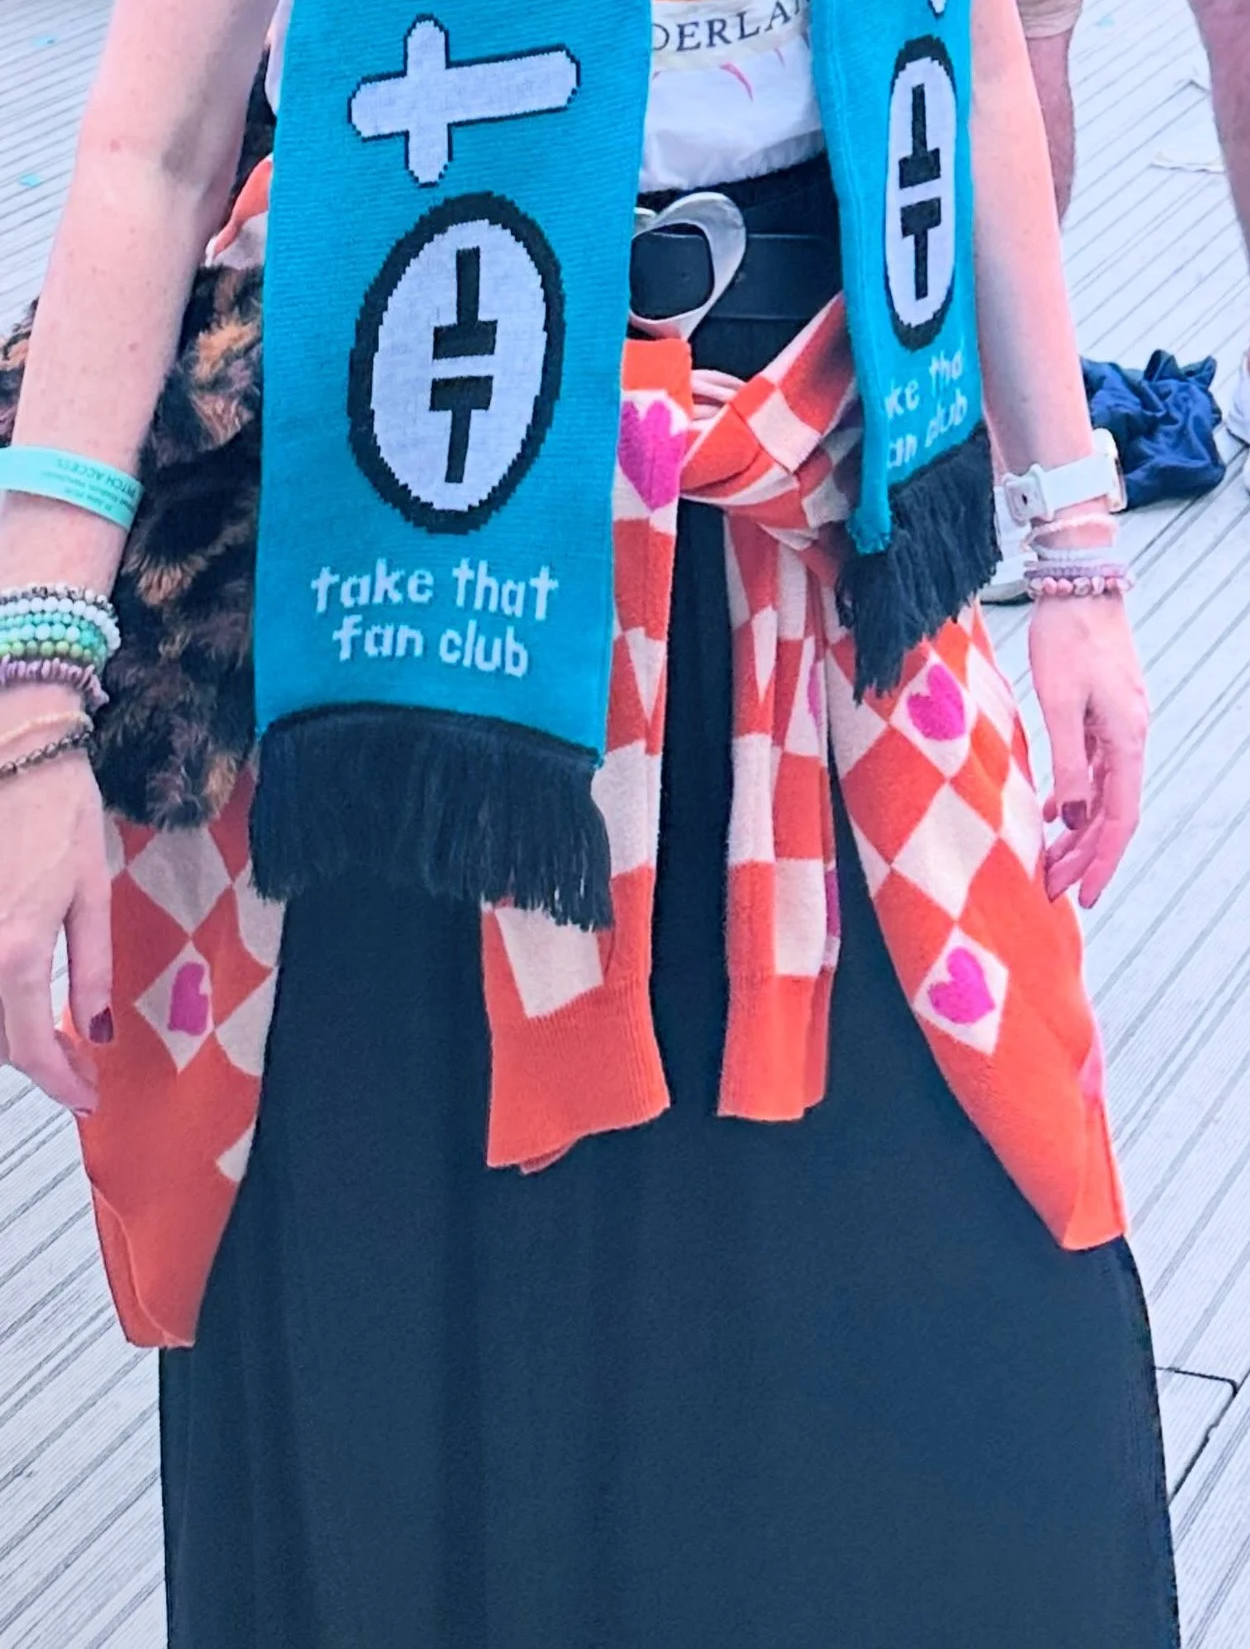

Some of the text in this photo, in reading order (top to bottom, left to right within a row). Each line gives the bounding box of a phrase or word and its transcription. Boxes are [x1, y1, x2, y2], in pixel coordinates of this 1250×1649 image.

[311, 558, 559, 621] take that
[332, 614, 528, 678] fan club
